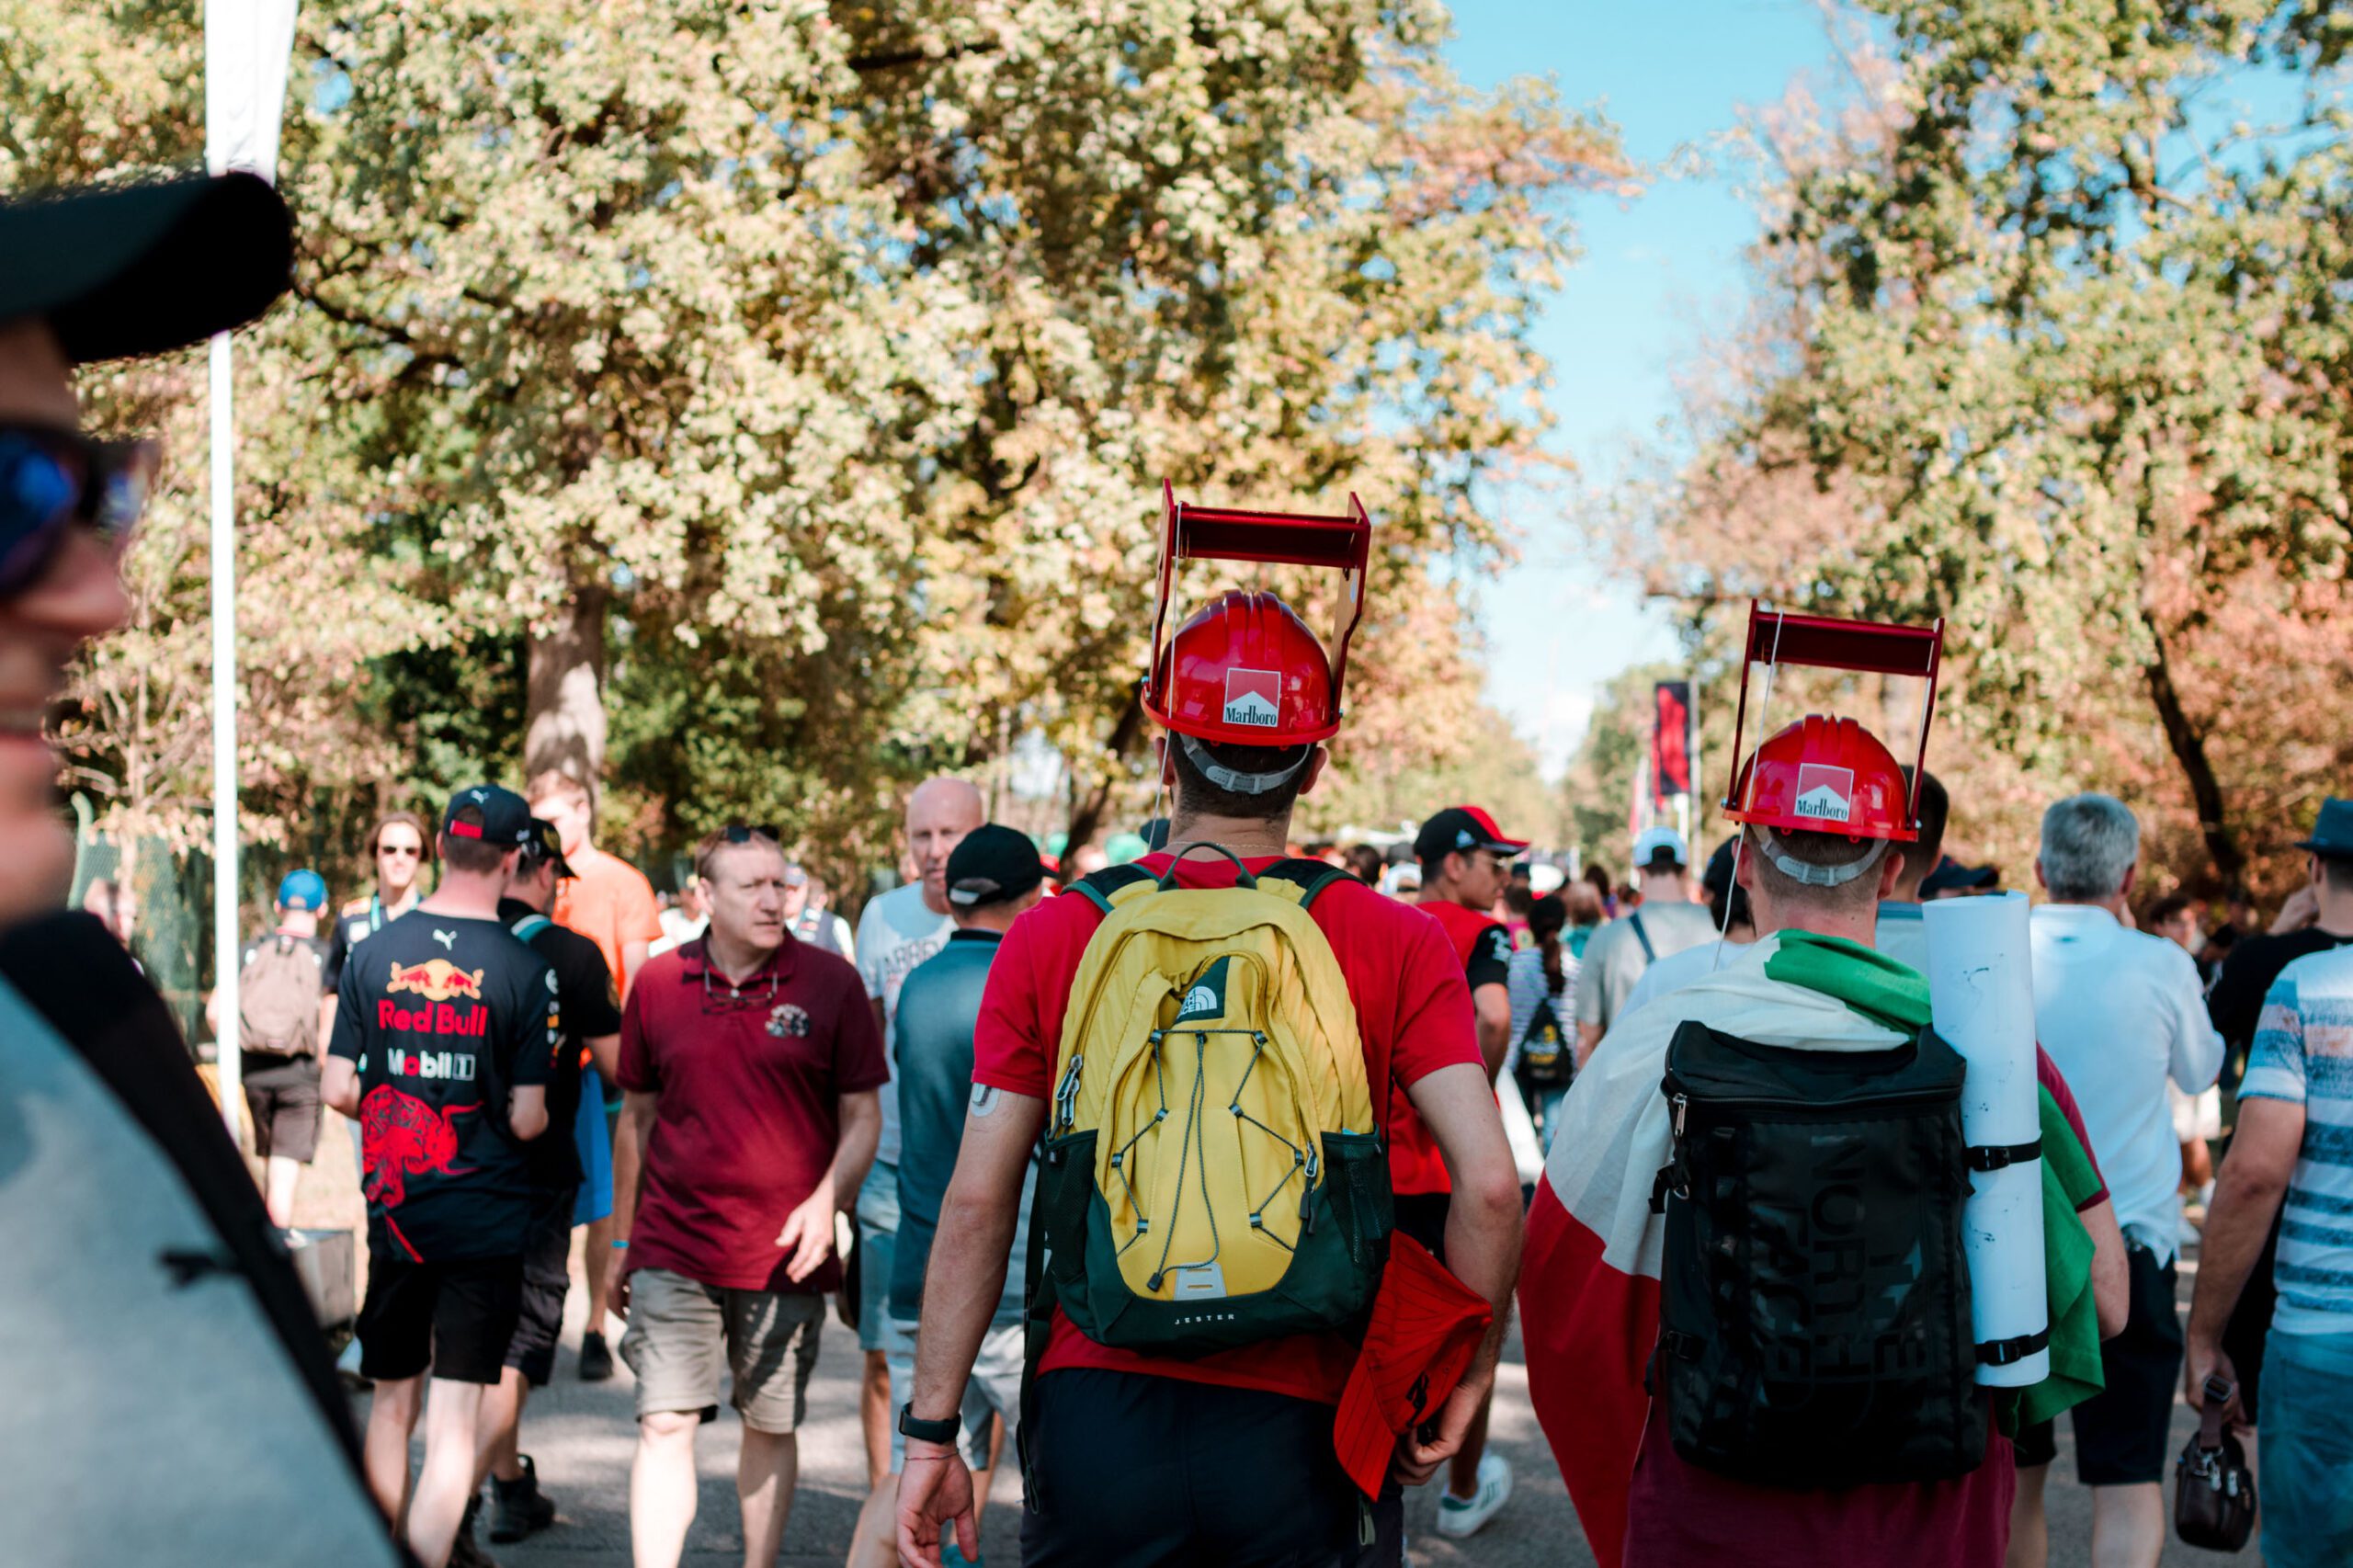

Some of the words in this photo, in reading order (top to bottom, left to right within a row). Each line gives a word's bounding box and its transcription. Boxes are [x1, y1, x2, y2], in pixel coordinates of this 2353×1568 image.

[1224, 705, 1277, 725] Marlboro
[1796, 798, 1847, 820] Marlboro
[378, 999, 434, 1033] Red
[436, 1003, 488, 1037] Bull
[388, 1047, 452, 1079] Mobil
[1811, 1135, 1867, 1376] NORTH
[1175, 1313, 1235, 1325] JESTER
